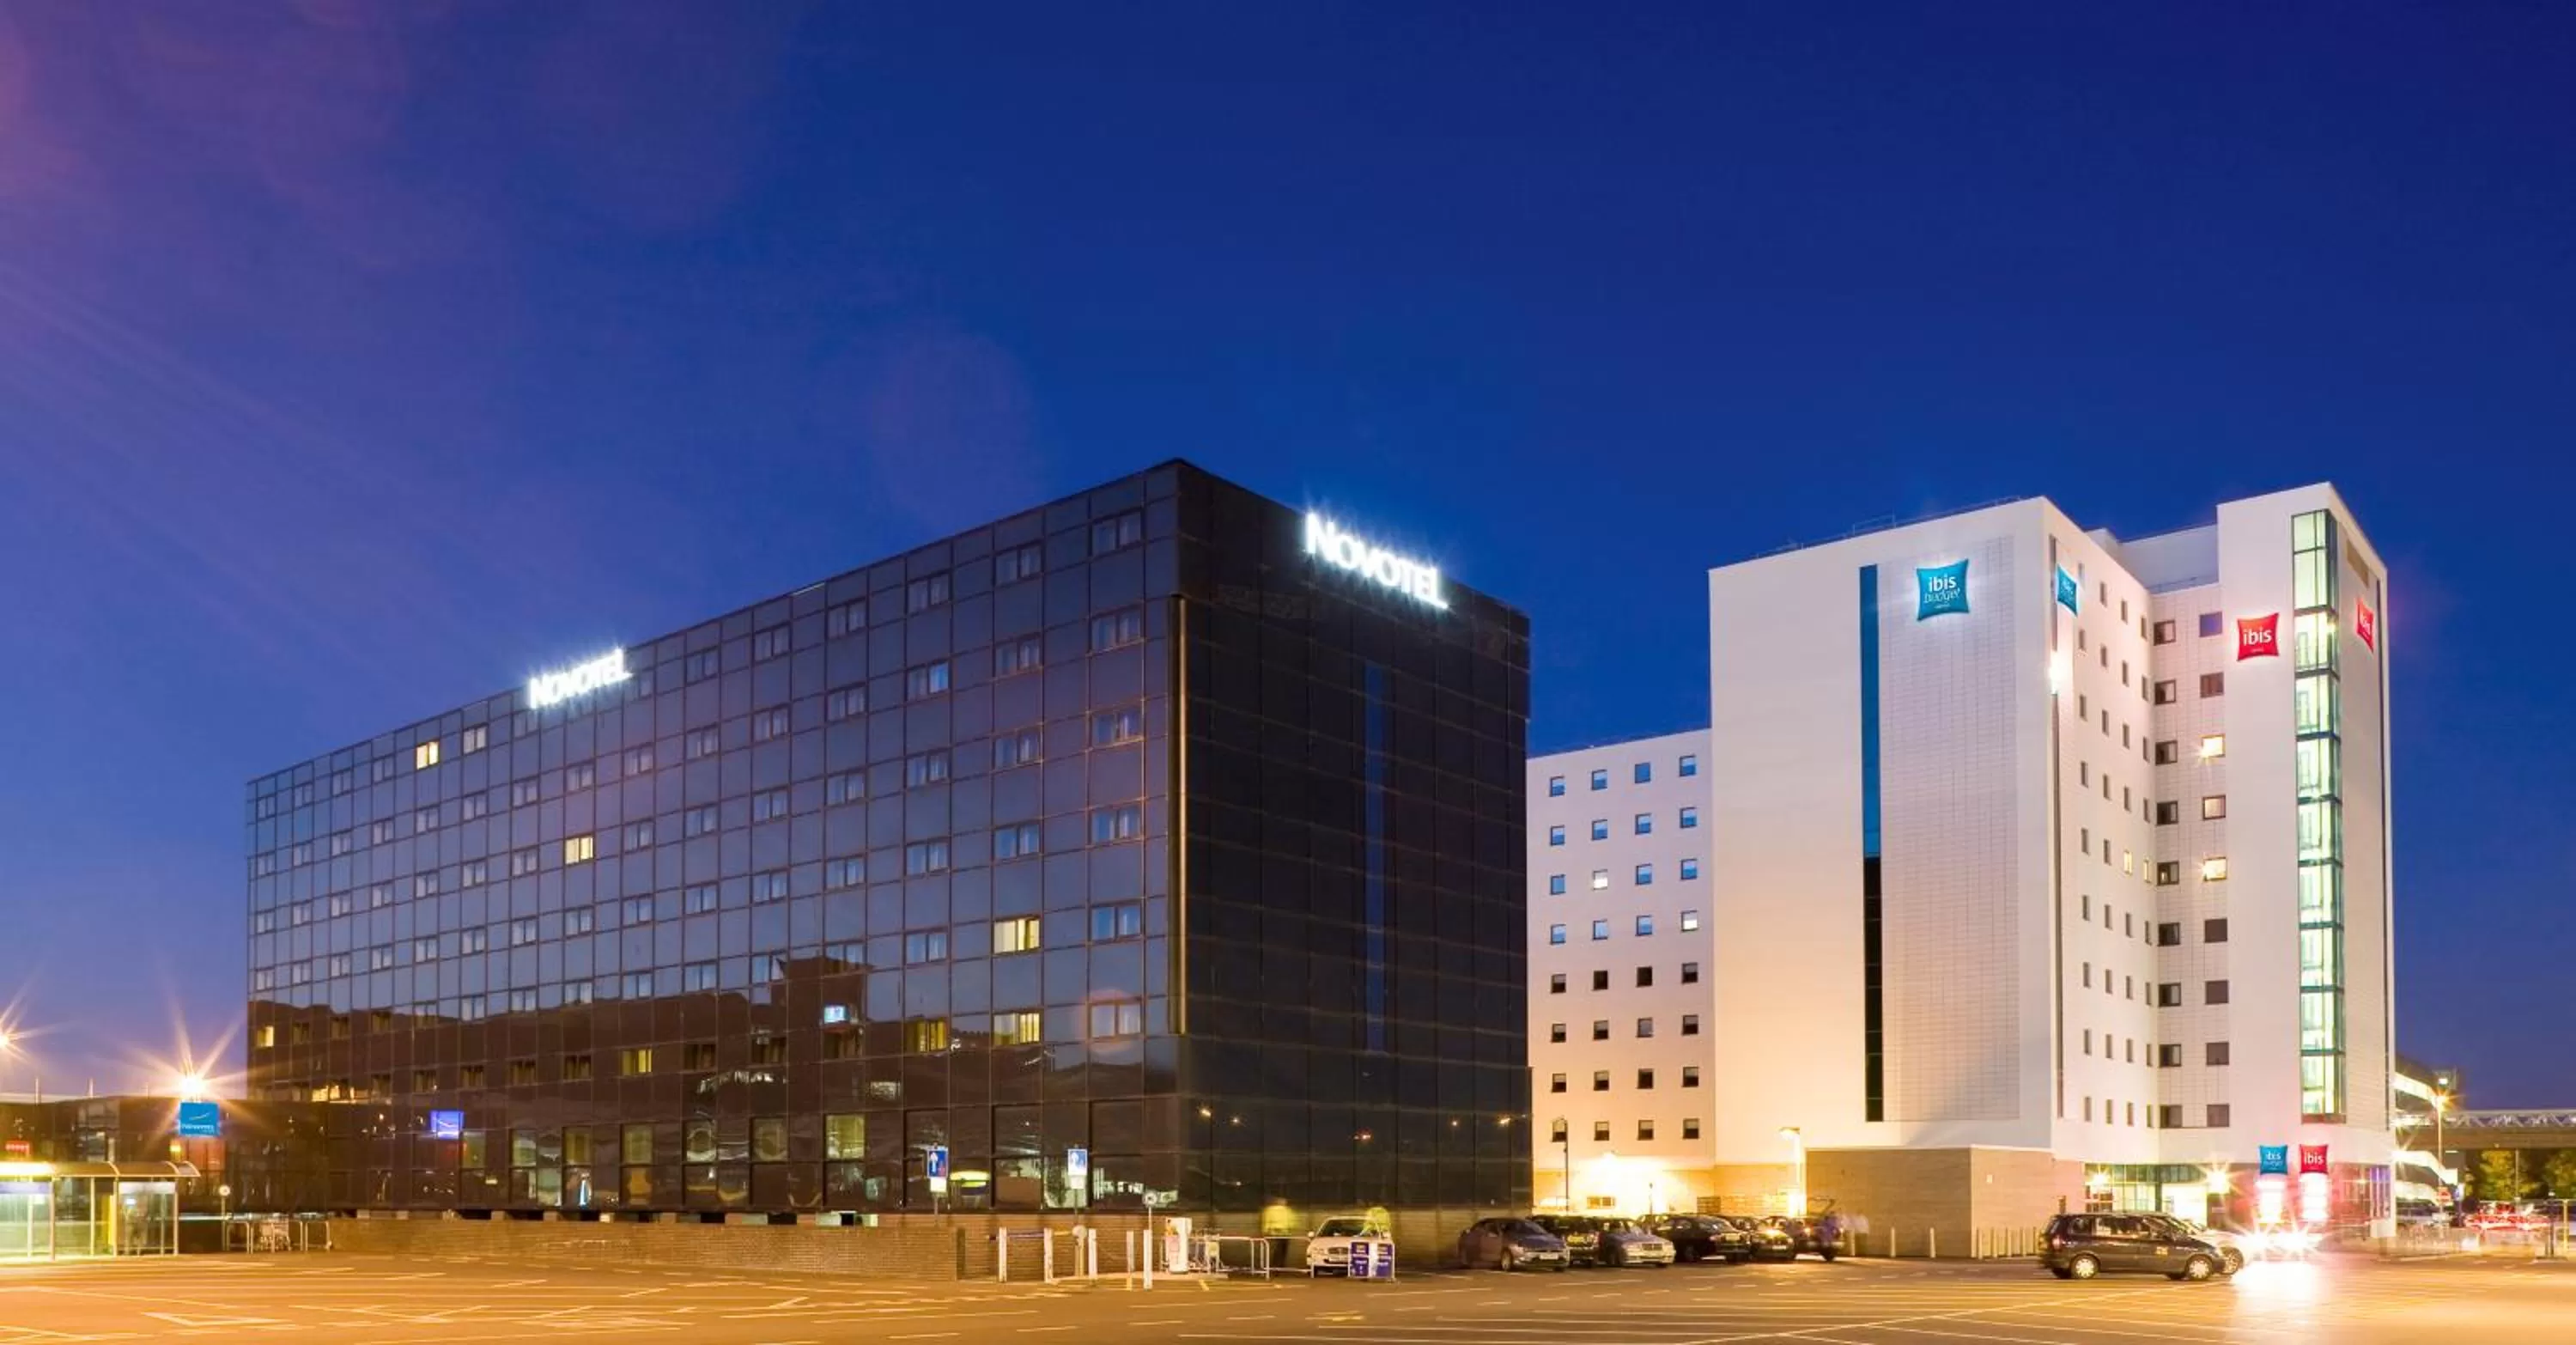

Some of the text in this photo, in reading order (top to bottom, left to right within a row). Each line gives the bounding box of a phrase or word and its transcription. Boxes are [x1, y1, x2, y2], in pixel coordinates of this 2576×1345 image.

[1305, 512, 1449, 609] NOVOTEL
[1928, 573, 1957, 593] ibis
[2243, 626, 2272, 646] ibis
[530, 648, 634, 709] NOVOTEL
[2304, 1151, 2324, 1165] ibis
